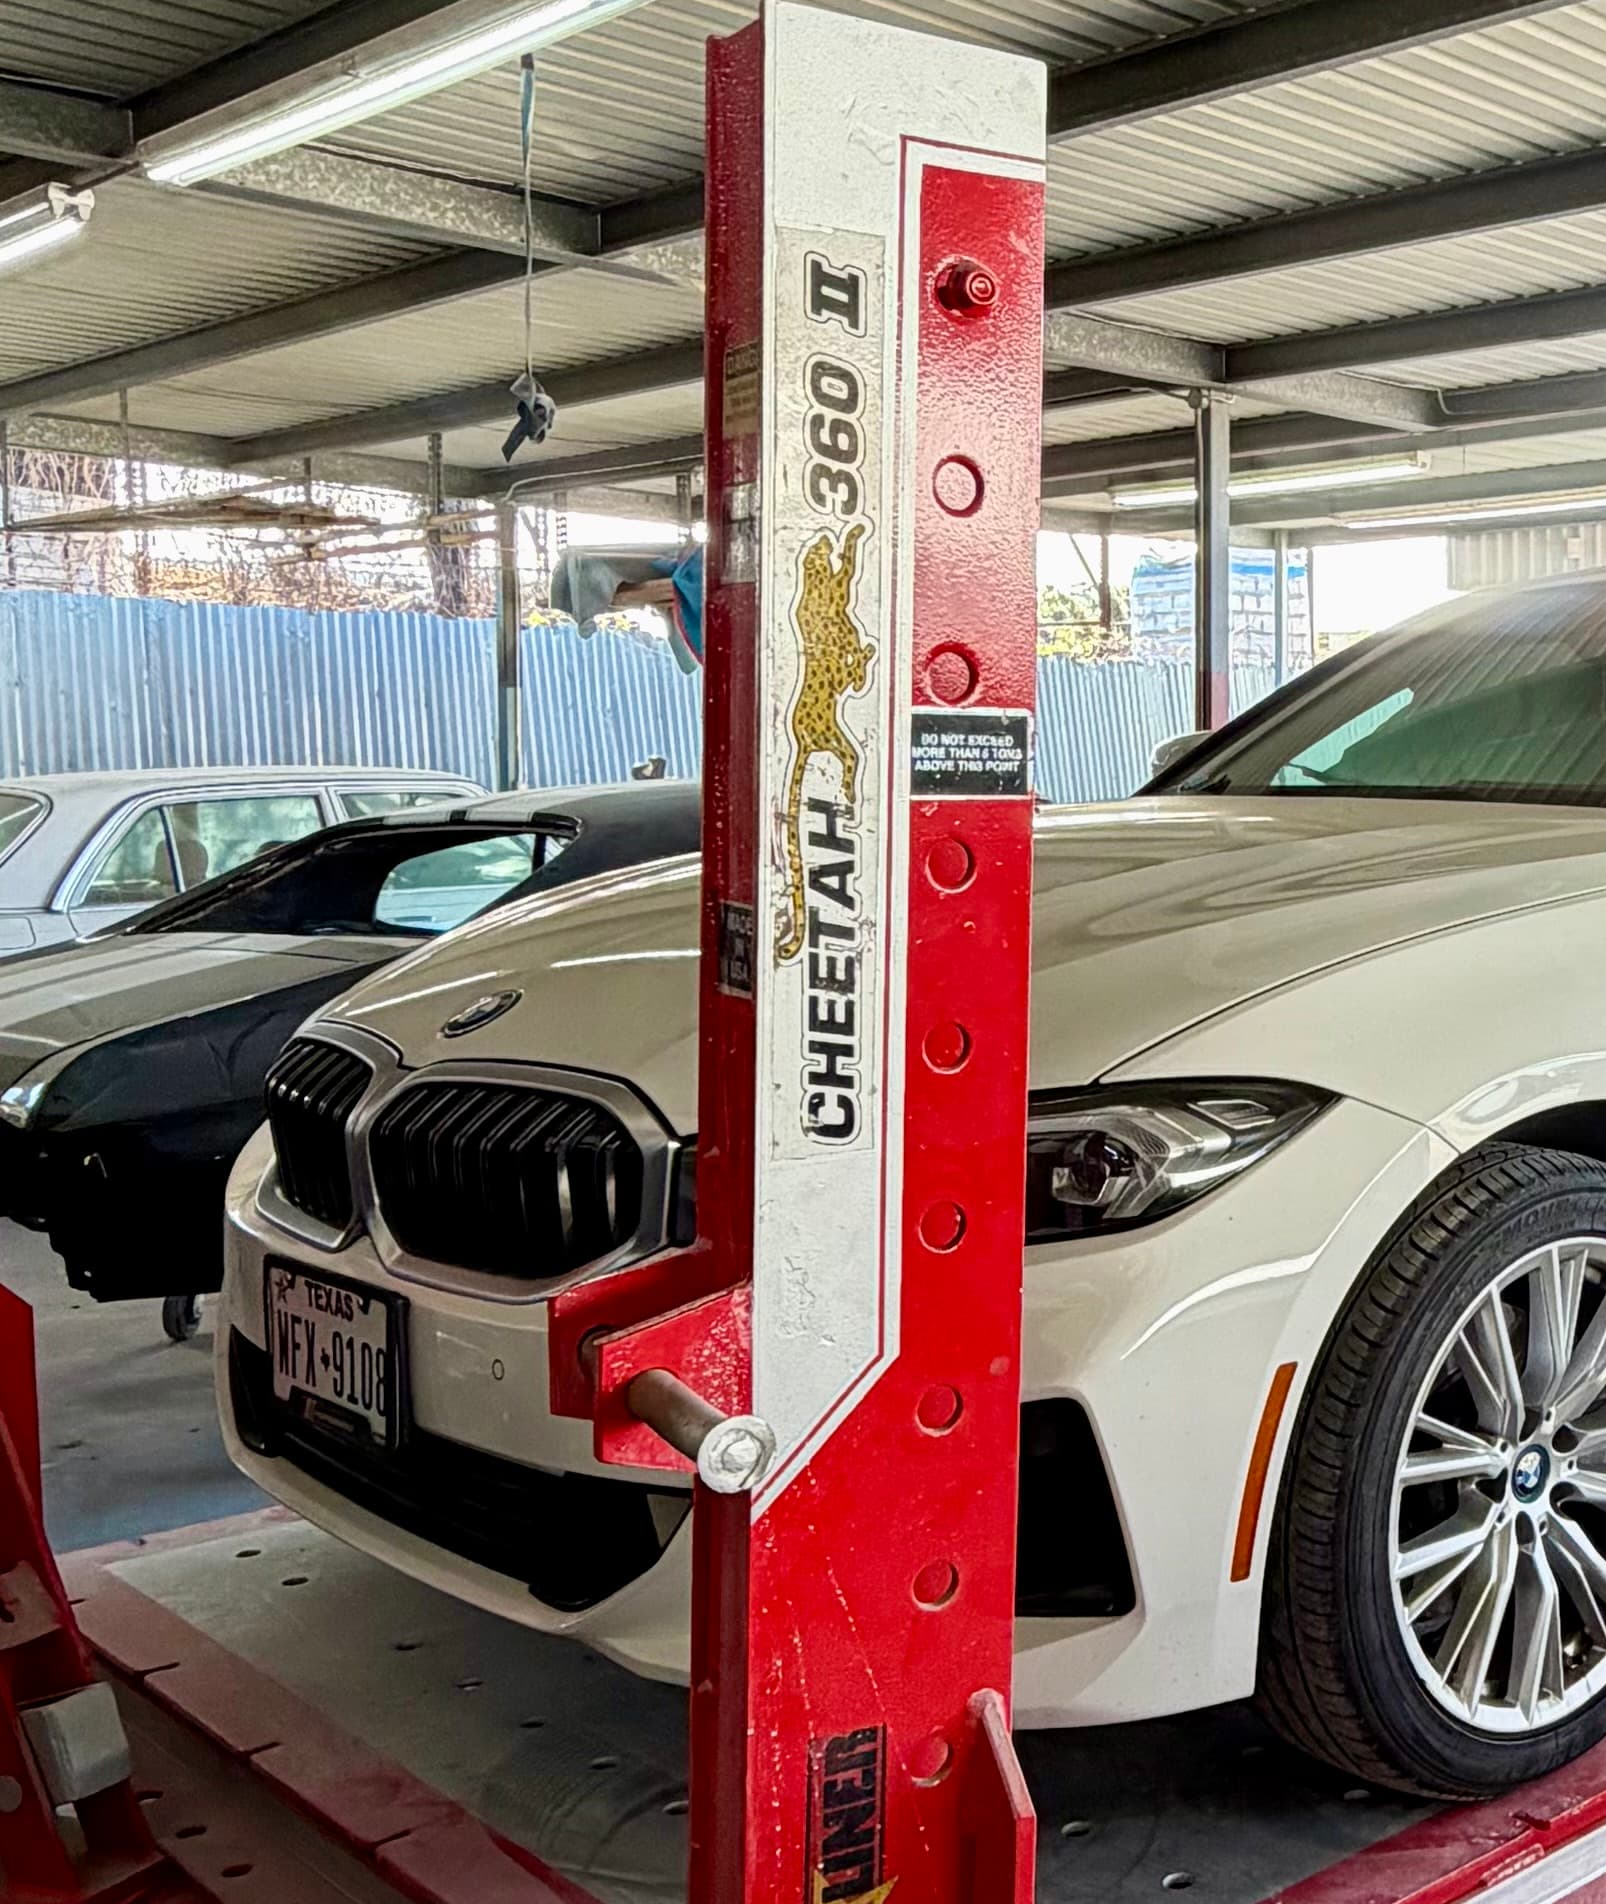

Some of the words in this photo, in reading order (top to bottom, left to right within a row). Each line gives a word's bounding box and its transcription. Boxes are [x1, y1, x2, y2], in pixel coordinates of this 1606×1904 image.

[809, 257, 861, 331] II
[809, 360, 860, 516] 360
[911, 747, 946, 759] MORE
[949, 747, 980, 759] THAN
[914, 760, 955, 772] ABOVE
[958, 760, 983, 772] THIS
[985, 761, 1020, 772] POINT
[921, 733, 938, 746] DO
[941, 734, 965, 747] NOT
[967, 734, 1014, 747] EXCEED
[806, 796, 857, 1140] CHEETAH
[304, 1279, 354, 1322] TEXAS
[821, 1726, 878, 1904] LINER
